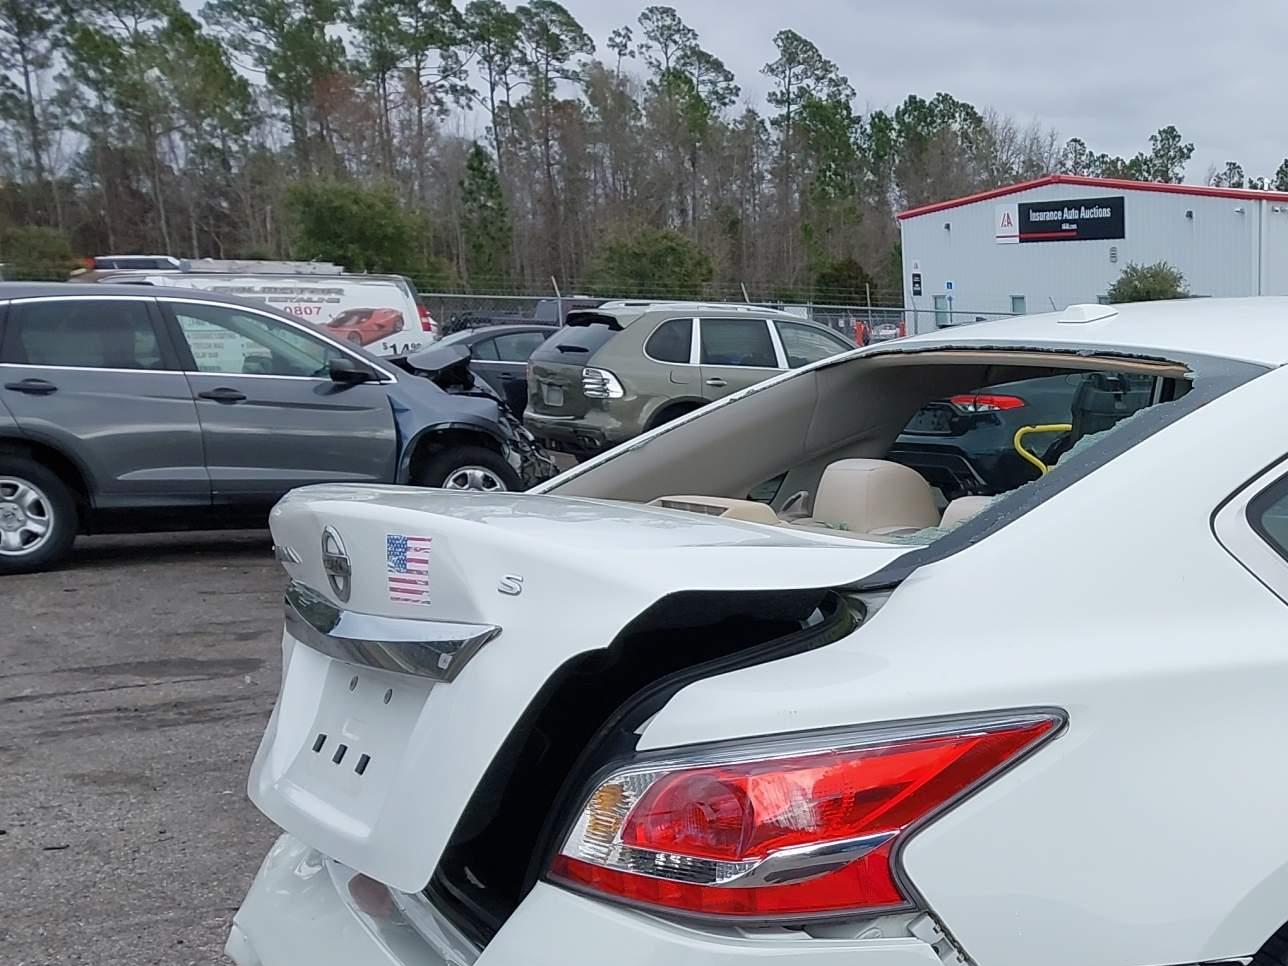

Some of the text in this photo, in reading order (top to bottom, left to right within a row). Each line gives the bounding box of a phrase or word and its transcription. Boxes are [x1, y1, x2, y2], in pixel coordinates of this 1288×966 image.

[1029, 205, 1111, 222] Insurance Auto Auctions
[497, 573, 524, 597] S
